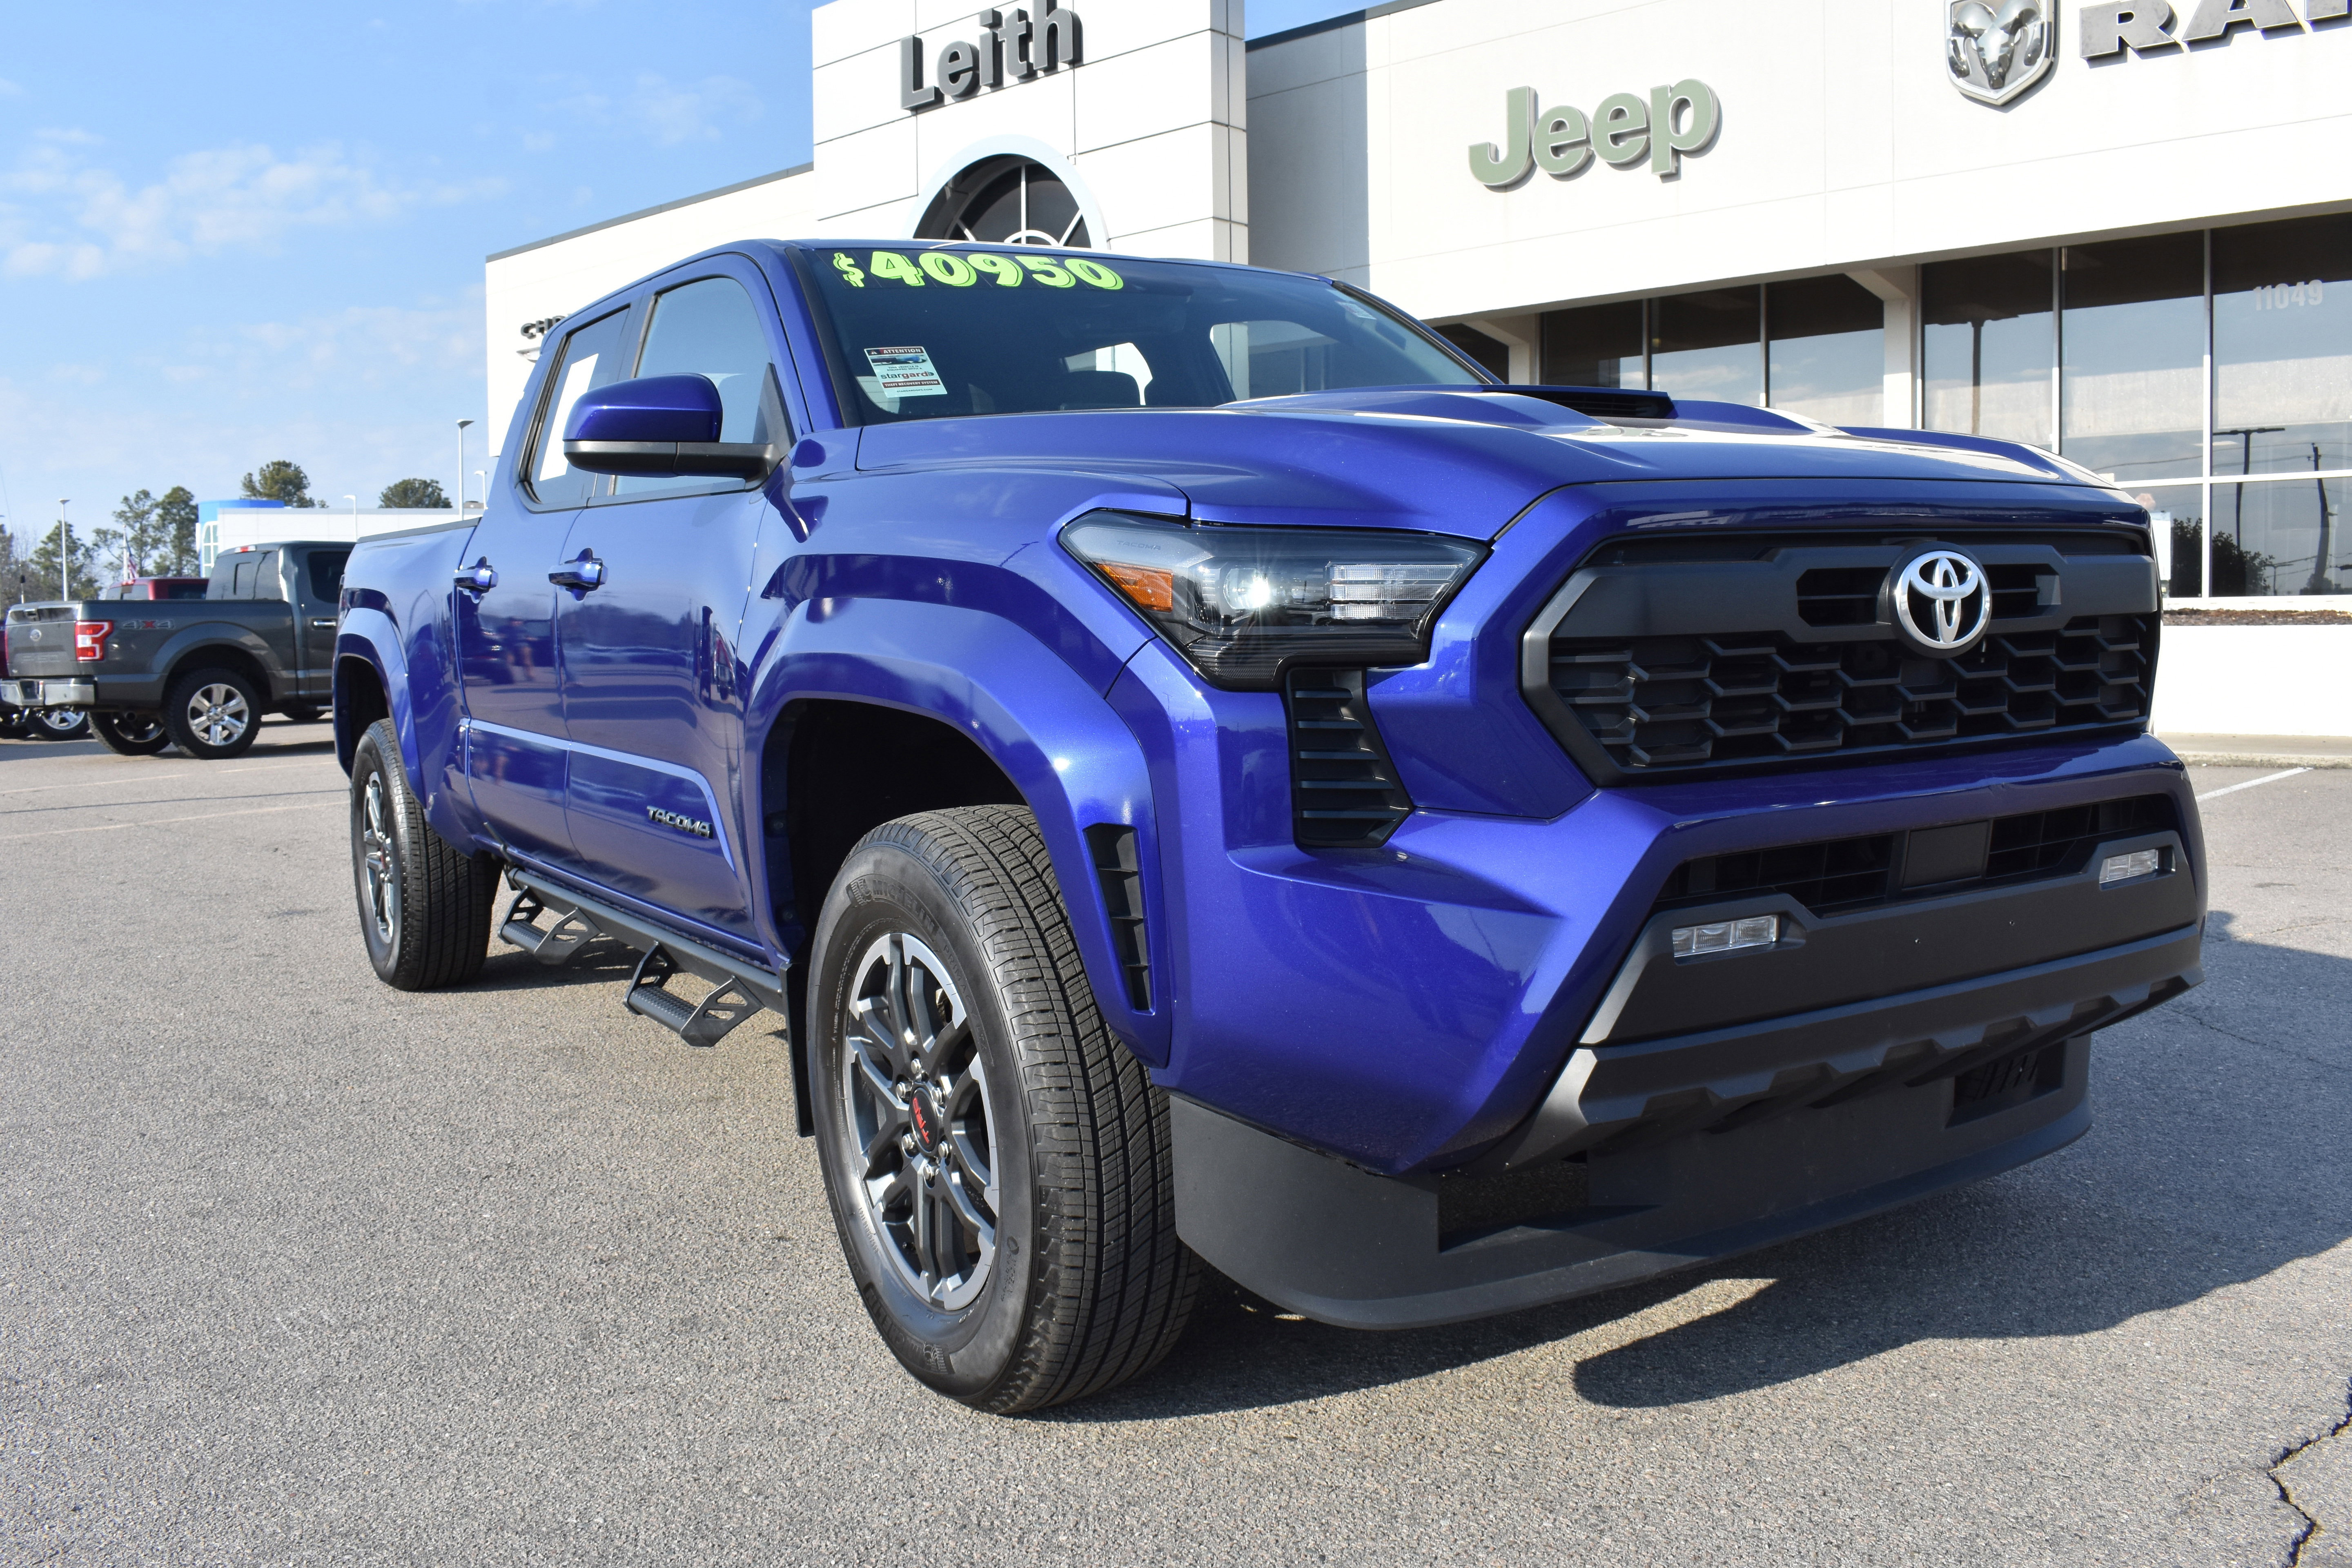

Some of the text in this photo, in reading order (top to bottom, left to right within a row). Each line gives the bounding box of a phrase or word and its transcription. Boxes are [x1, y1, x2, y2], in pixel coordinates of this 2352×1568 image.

[900, 0, 1083, 109] Leith
[2079, 0, 2352, 60] RA
[1468, 78, 1719, 188] Jeep
[833, 251, 1124, 290] $40950
[2253, 279, 2323, 311] 11049
[1116, 540, 1161, 551] TACOMA
[646, 805, 713, 839] TACOMA
[872, 879, 935, 933] MICHELIN
[943, 944, 977, 1017] PRIMACY
[913, 1097, 930, 1144] TRD
